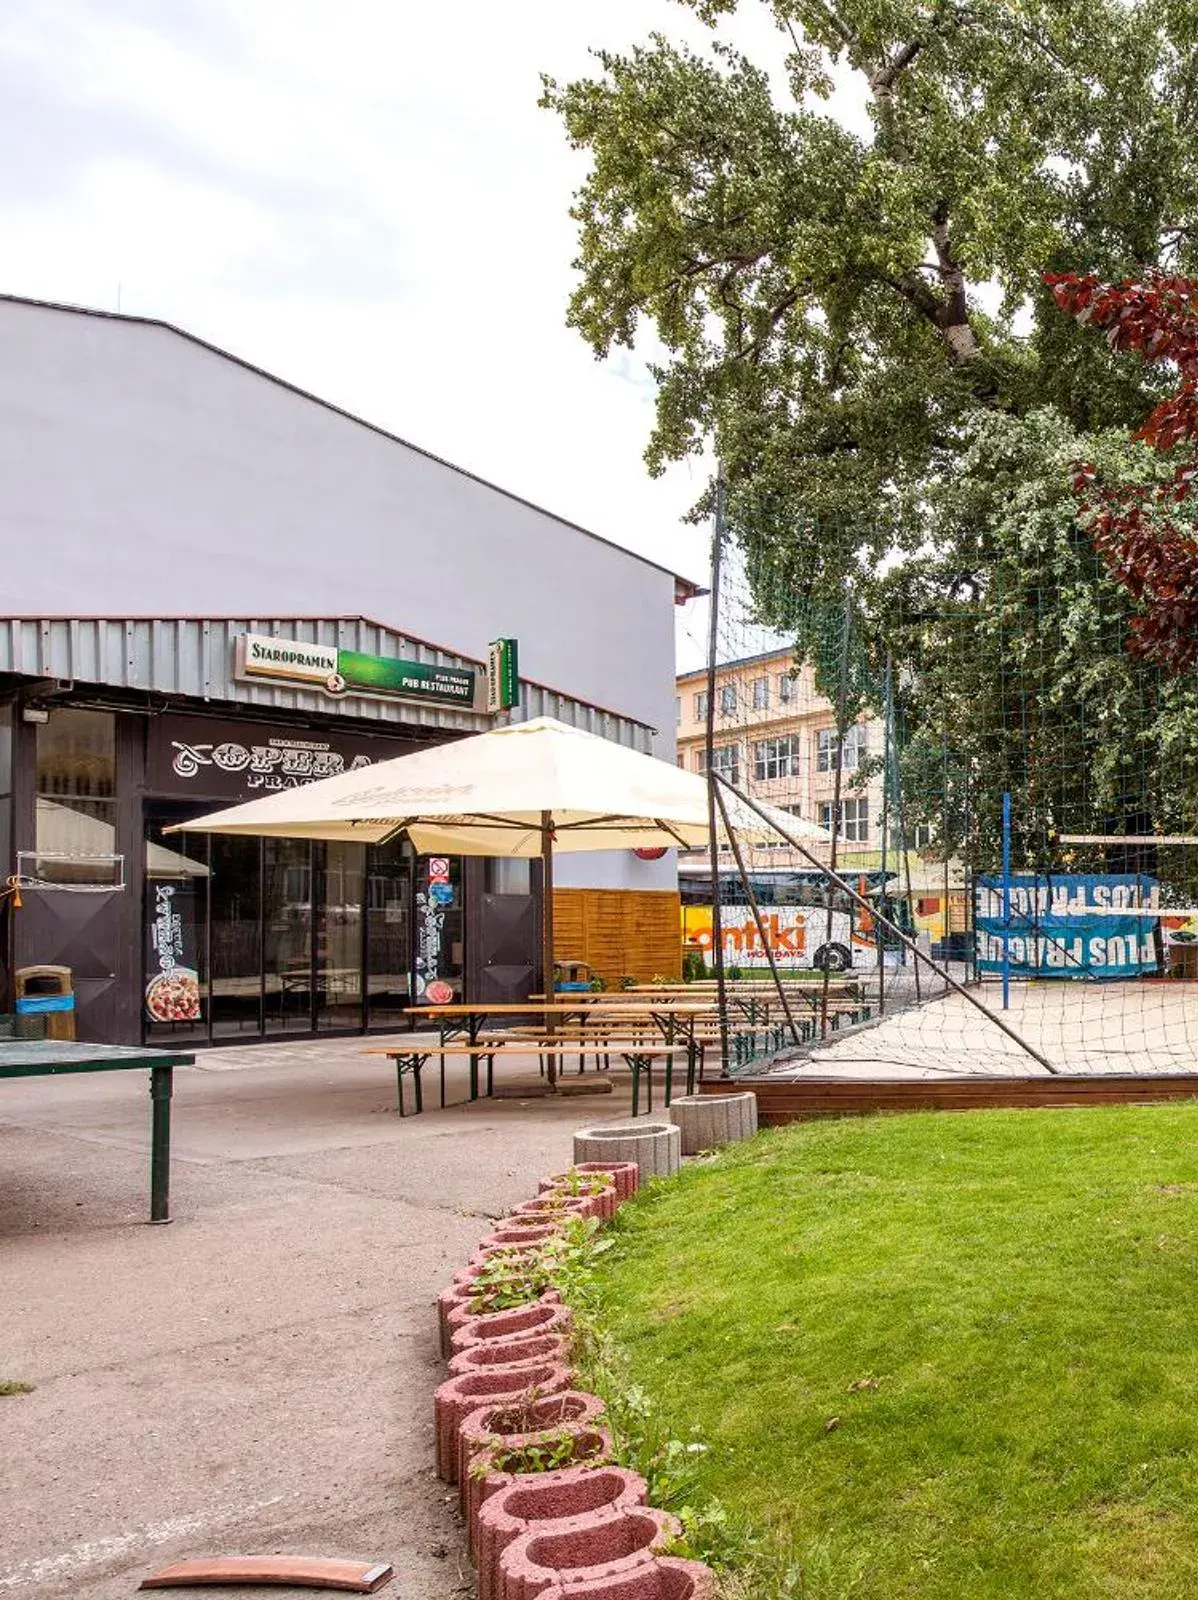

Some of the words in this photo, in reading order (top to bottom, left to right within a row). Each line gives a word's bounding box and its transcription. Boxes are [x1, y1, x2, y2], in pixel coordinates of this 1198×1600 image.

[252, 642, 335, 669] STAROPRAMEN
[402, 677, 419, 689] PUB
[421, 681, 468, 697] RESTAURANT
[682, 914, 805, 951] ontiki
[975, 930, 1083, 967] PRAGUE
[1089, 932, 1157, 966] PLUS
